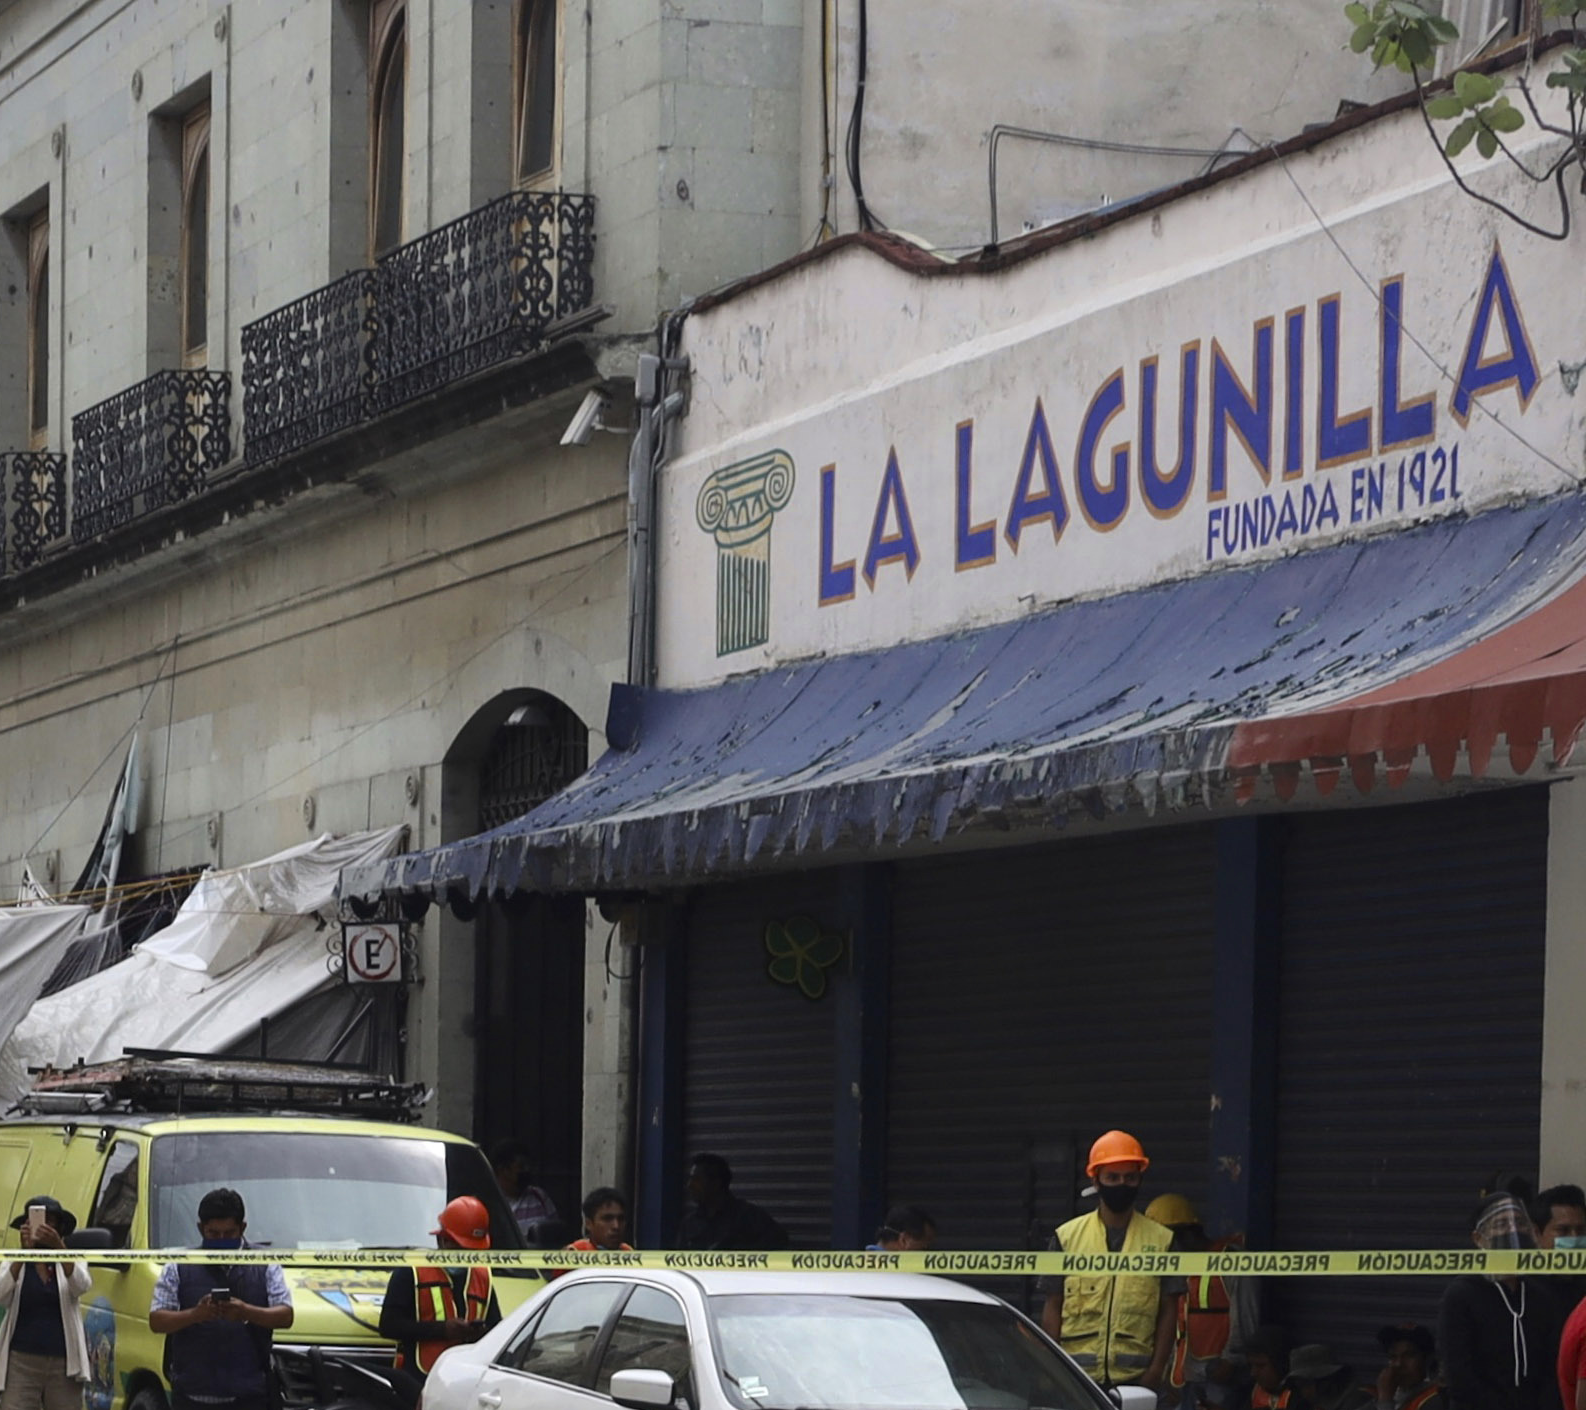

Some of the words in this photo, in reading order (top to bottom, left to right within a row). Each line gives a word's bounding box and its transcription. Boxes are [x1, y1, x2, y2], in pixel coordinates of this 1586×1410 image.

[819, 445, 921, 606] LA
[955, 238, 1542, 573] LAGUNILLA
[1206, 478, 1340, 561] FUNDADA
[1351, 461, 1386, 523] EN
[1395, 441, 1462, 515] 1921
